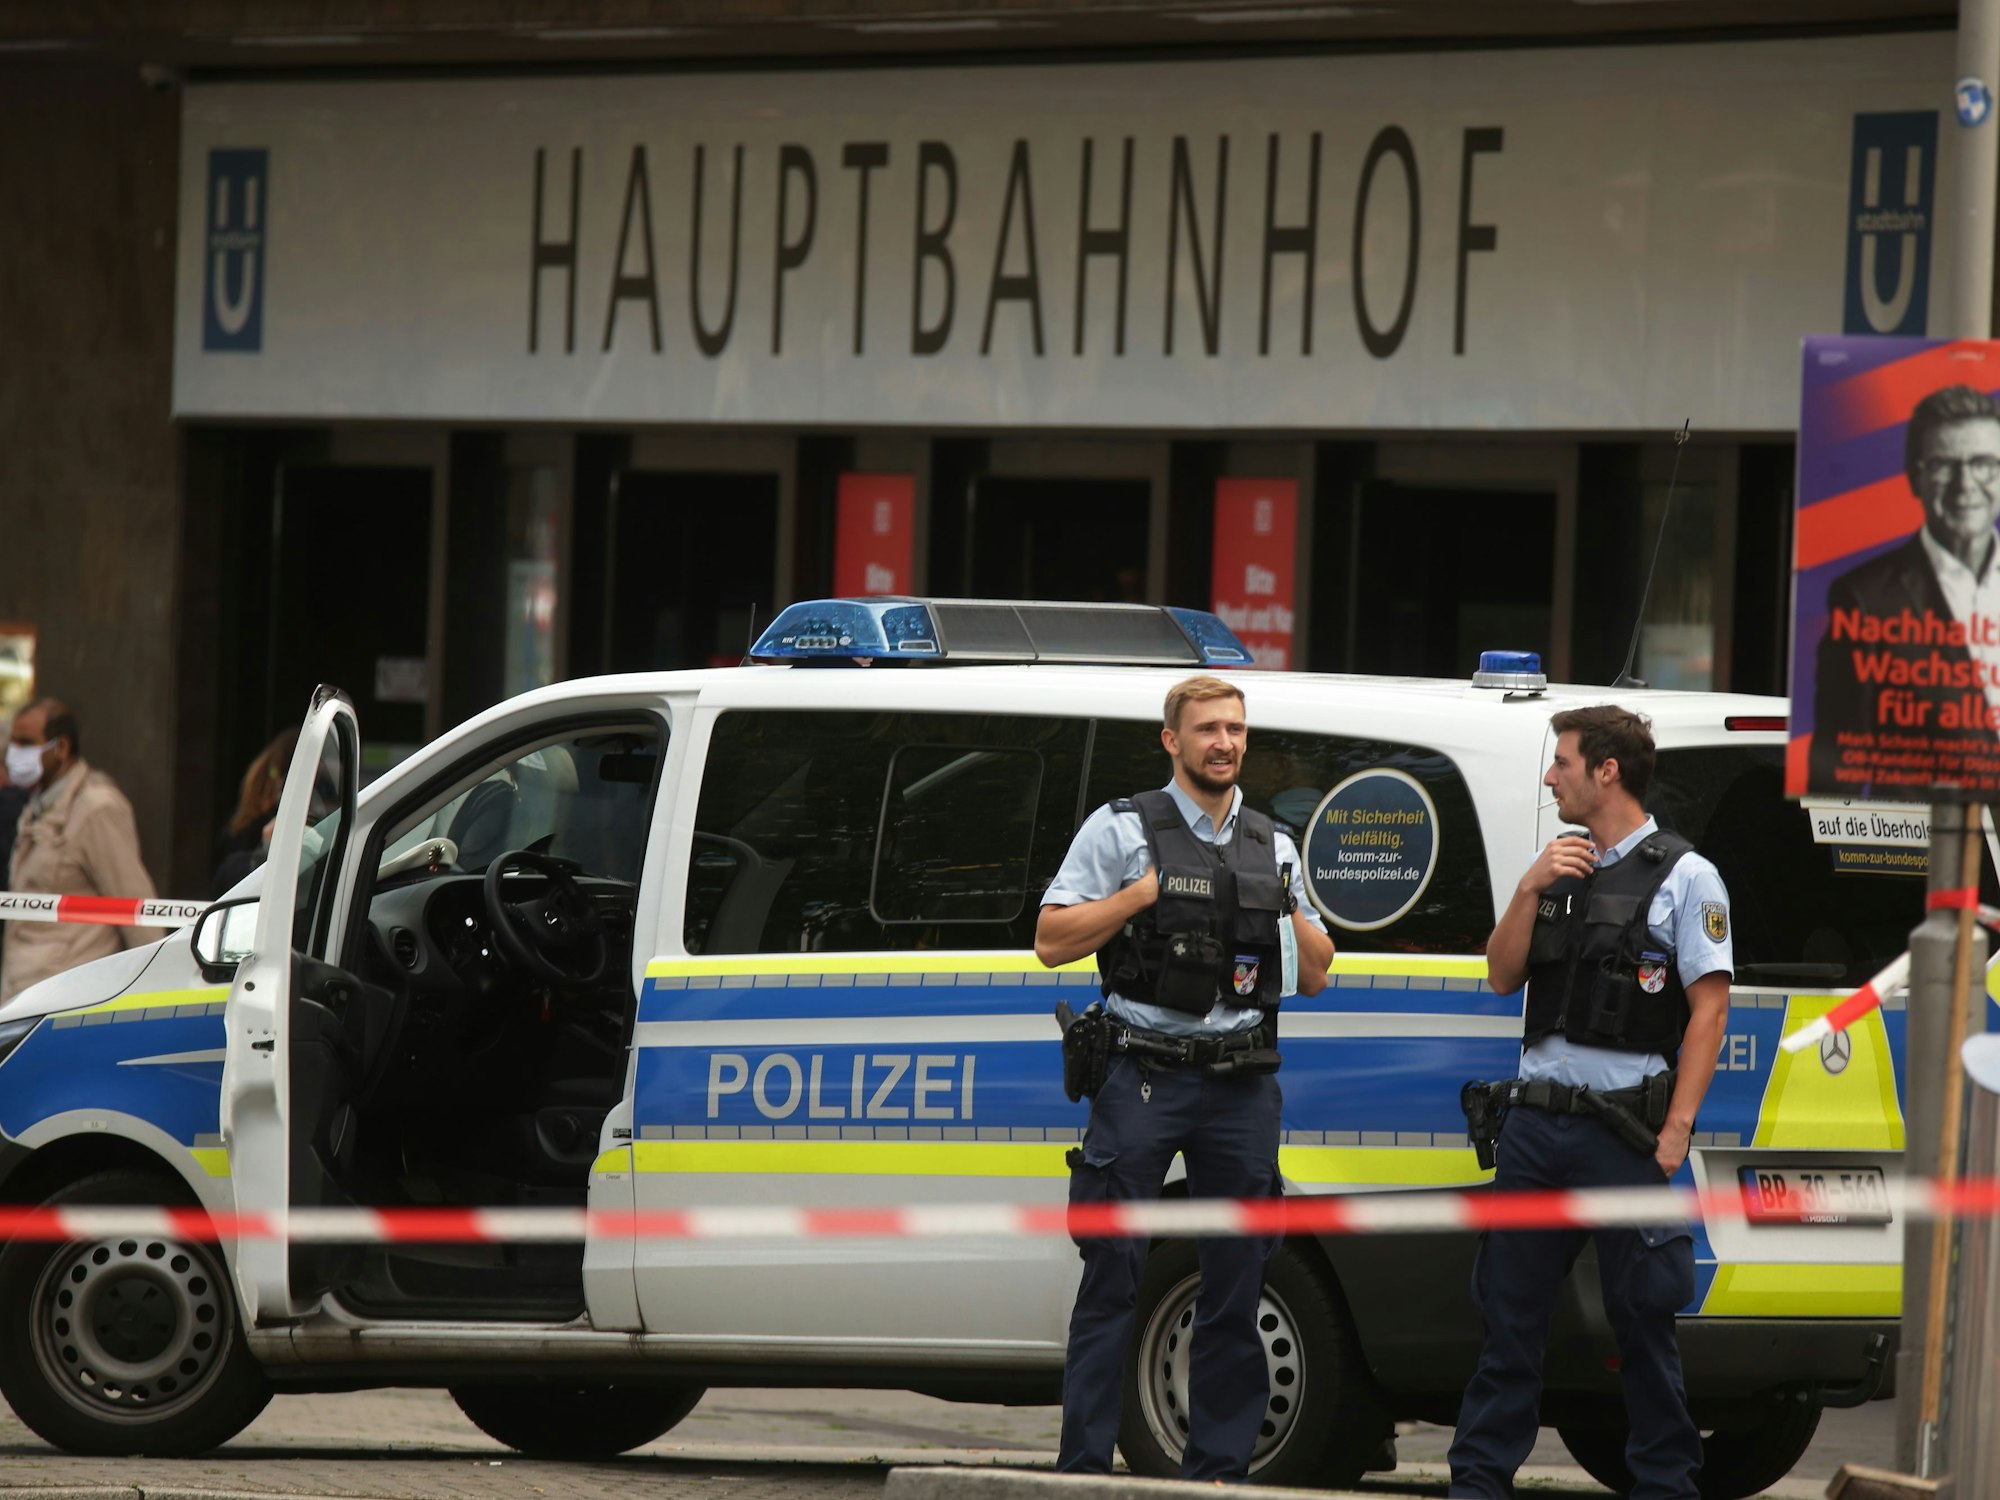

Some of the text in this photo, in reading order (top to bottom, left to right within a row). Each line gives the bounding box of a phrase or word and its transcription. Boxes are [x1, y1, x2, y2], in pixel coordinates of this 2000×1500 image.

[528, 124, 1504, 360] HAUPTBAHNHOF
[1832, 608, 2000, 646] Nachhalt
[1878, 688, 1933, 727] für
[1326, 809, 1425, 825] Mit Sicherheit
[1818, 816, 1841, 836] auf
[1845, 817, 1868, 837] die
[1340, 830, 1404, 849] vielfältig.
[1337, 850, 1402, 863] komm-zur-
[1839, 849, 1930, 869] komm-zur-bundespo
[1316, 867, 1420, 882] bundespolizei.de
[1168, 876, 1210, 895] POLIZEI
[0, 898, 54, 910] POLIZ
[707, 1053, 976, 1120] POLIZEI
[1759, 1174, 1787, 1209] BP
